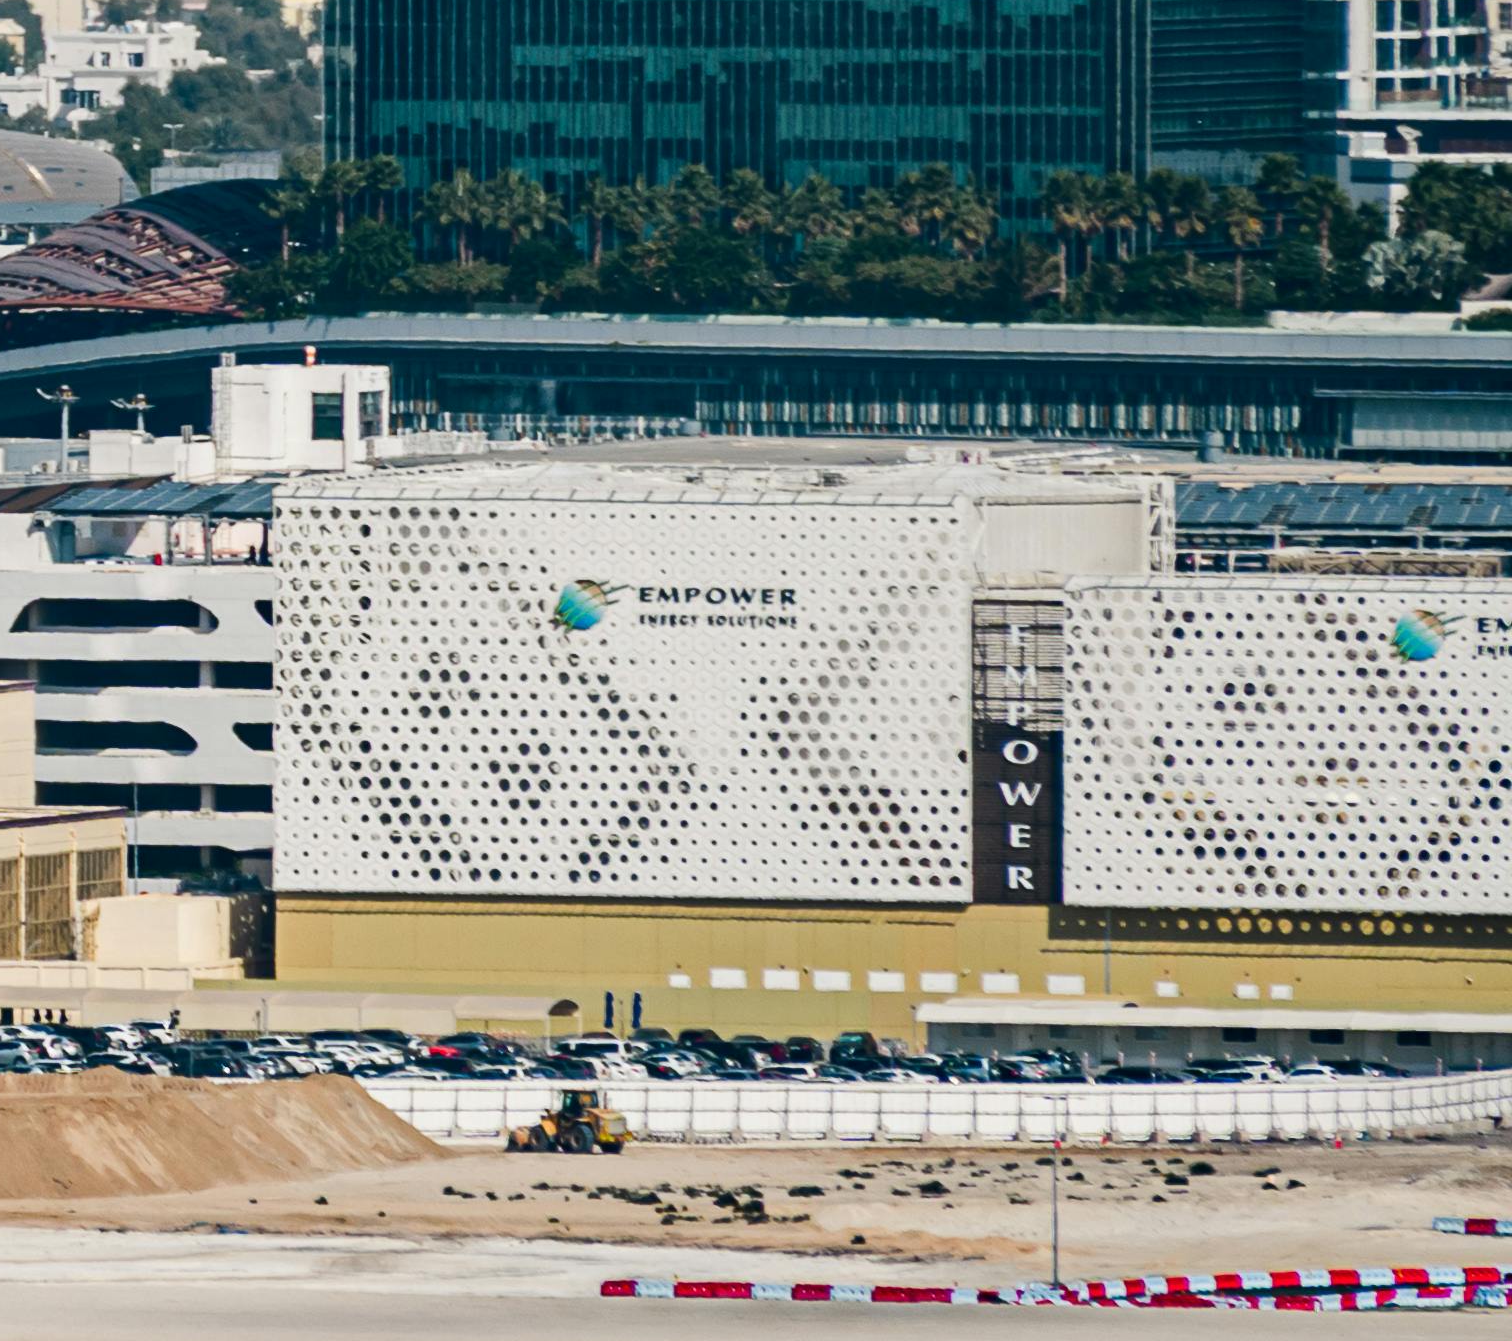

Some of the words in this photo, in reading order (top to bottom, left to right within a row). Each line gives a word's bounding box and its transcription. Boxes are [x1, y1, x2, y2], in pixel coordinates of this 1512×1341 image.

[639, 587, 797, 605] EMPOWER
[639, 615, 698, 628] ENERGY
[707, 615, 797, 629] SOLUTIONS
[998, 624, 1042, 890] EMPOWER
